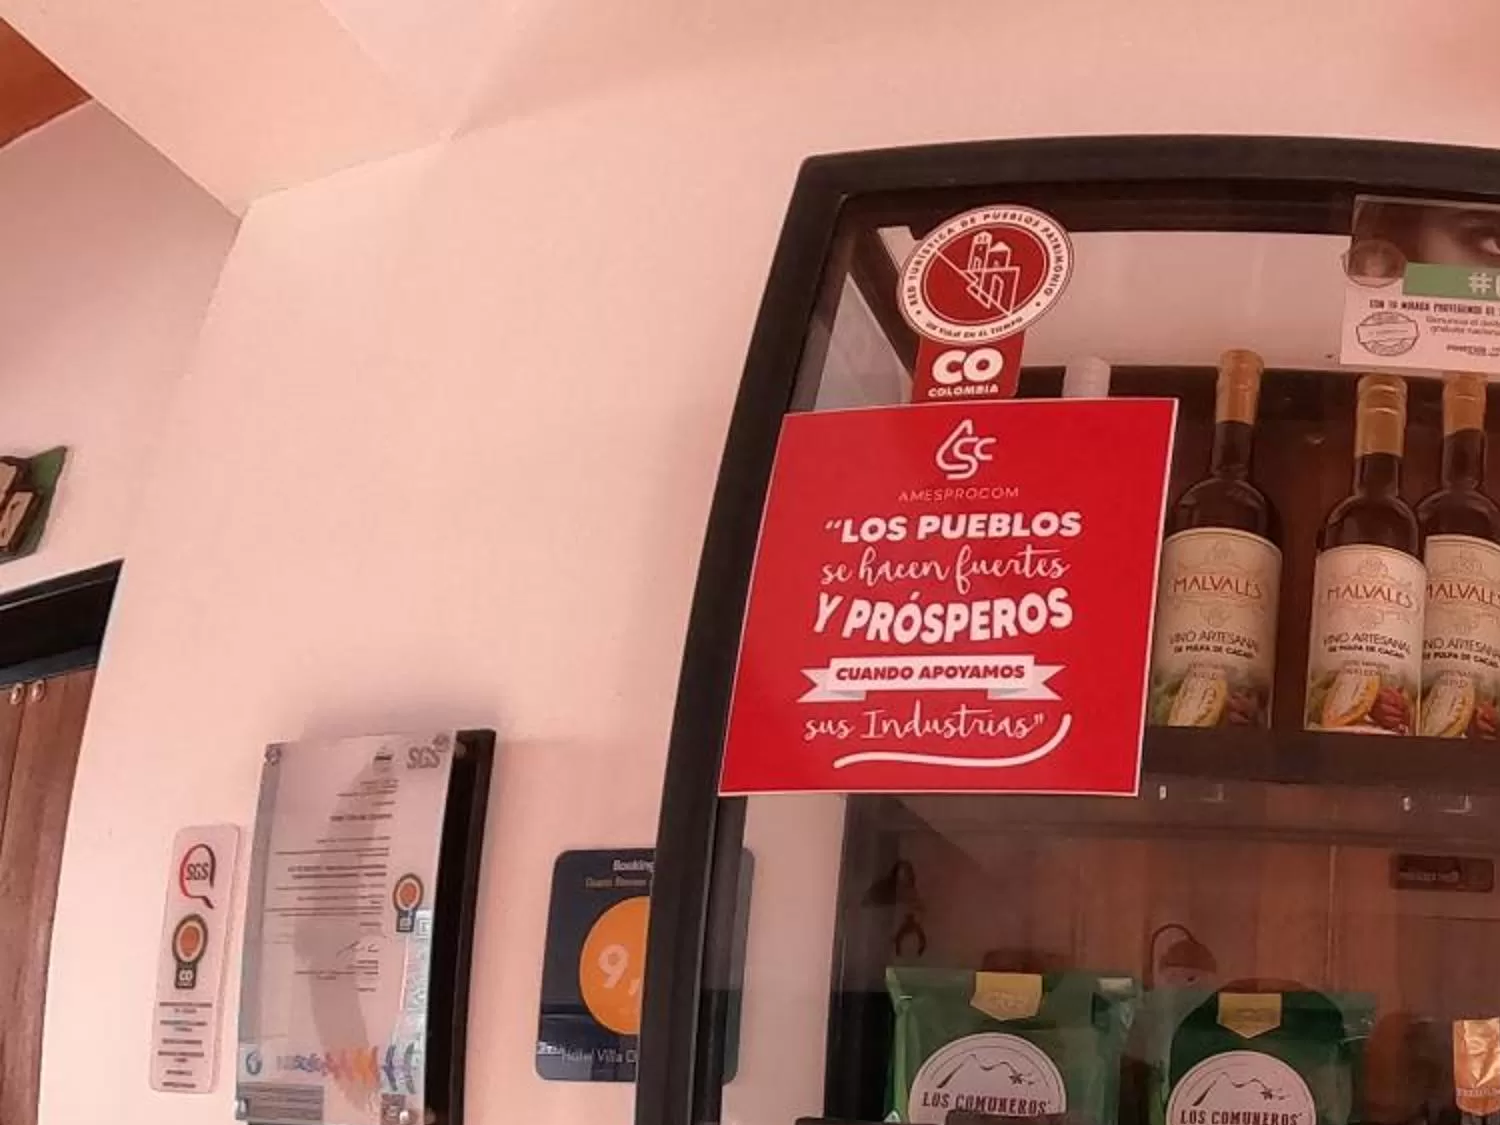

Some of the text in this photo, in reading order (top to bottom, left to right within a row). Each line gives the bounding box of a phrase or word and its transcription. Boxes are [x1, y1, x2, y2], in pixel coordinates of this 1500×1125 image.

[932, 348, 1003, 384] CO
[928, 383, 999, 397] COLOMBIA
[898, 486, 1019, 503] AMESPROCOM
[917, 511, 1082, 540] PUEBLOS
[821, 544, 1071, 594] se hacen fuertes
[813, 587, 1073, 644] Y PRÓSPEROS
[836, 664, 1025, 681] CUANDO APOYAMOS
[803, 715, 855, 739] sus
[407, 746, 441, 769] SGS
[186, 863, 209, 881] SGS
[922, 1092, 1047, 1116] LOS COMUNEROS
[1180, 1110, 1206, 1125] LOS
